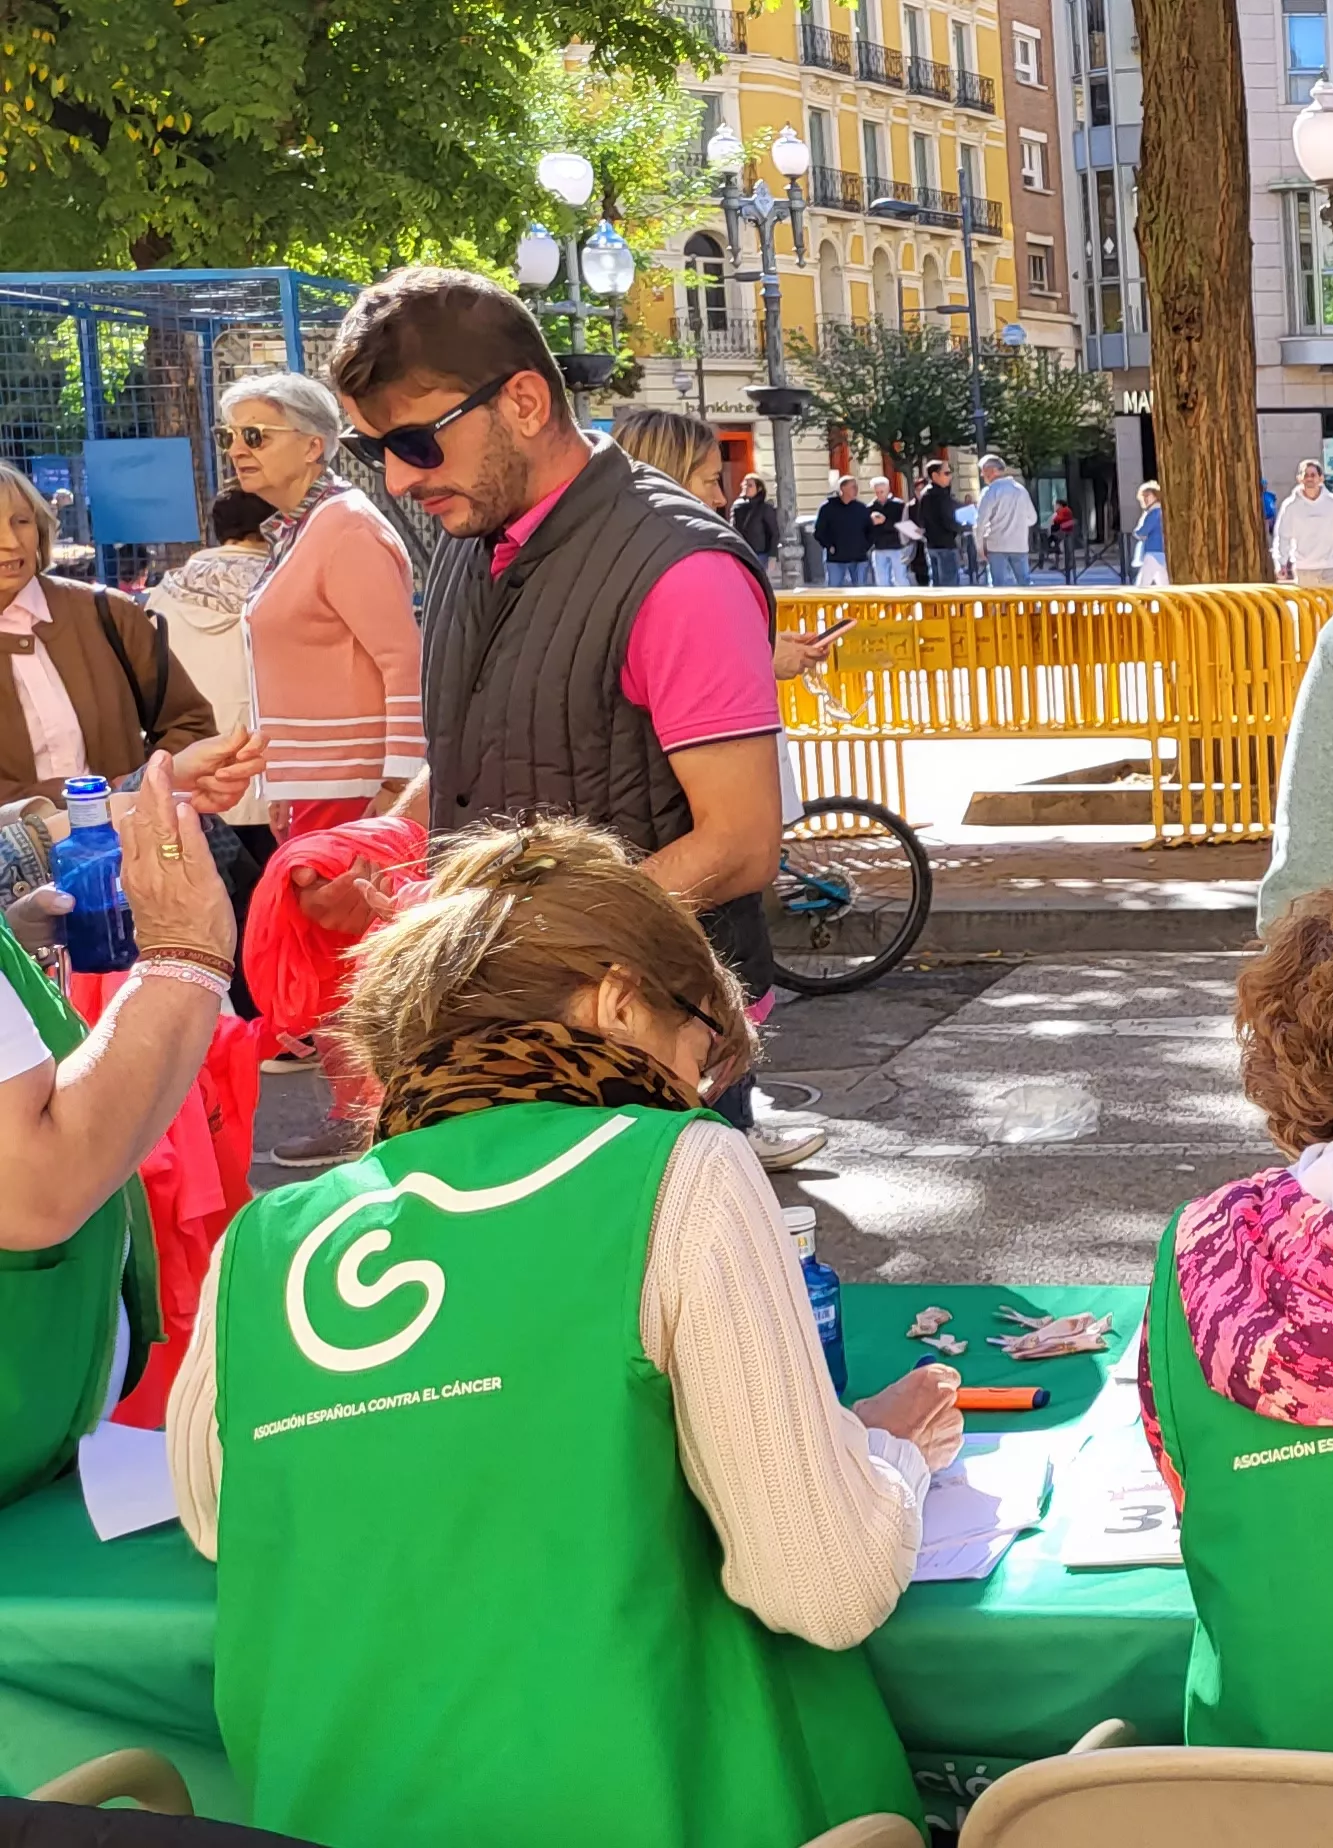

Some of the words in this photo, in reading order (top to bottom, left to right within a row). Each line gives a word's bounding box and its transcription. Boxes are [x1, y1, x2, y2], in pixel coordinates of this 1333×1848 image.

[253, 1414, 307, 1441] ASOCIACIÓN
[306, 1403, 367, 1426] ESPAÑOLA
[367, 1390, 421, 1413] CONTRA
[422, 1387, 440, 1402] EL
[441, 1376, 502, 1398] CÁNCER
[1233, 1440, 1316, 1471] ASOCIACIÓN
[1103, 1505, 1179, 1534] 3
